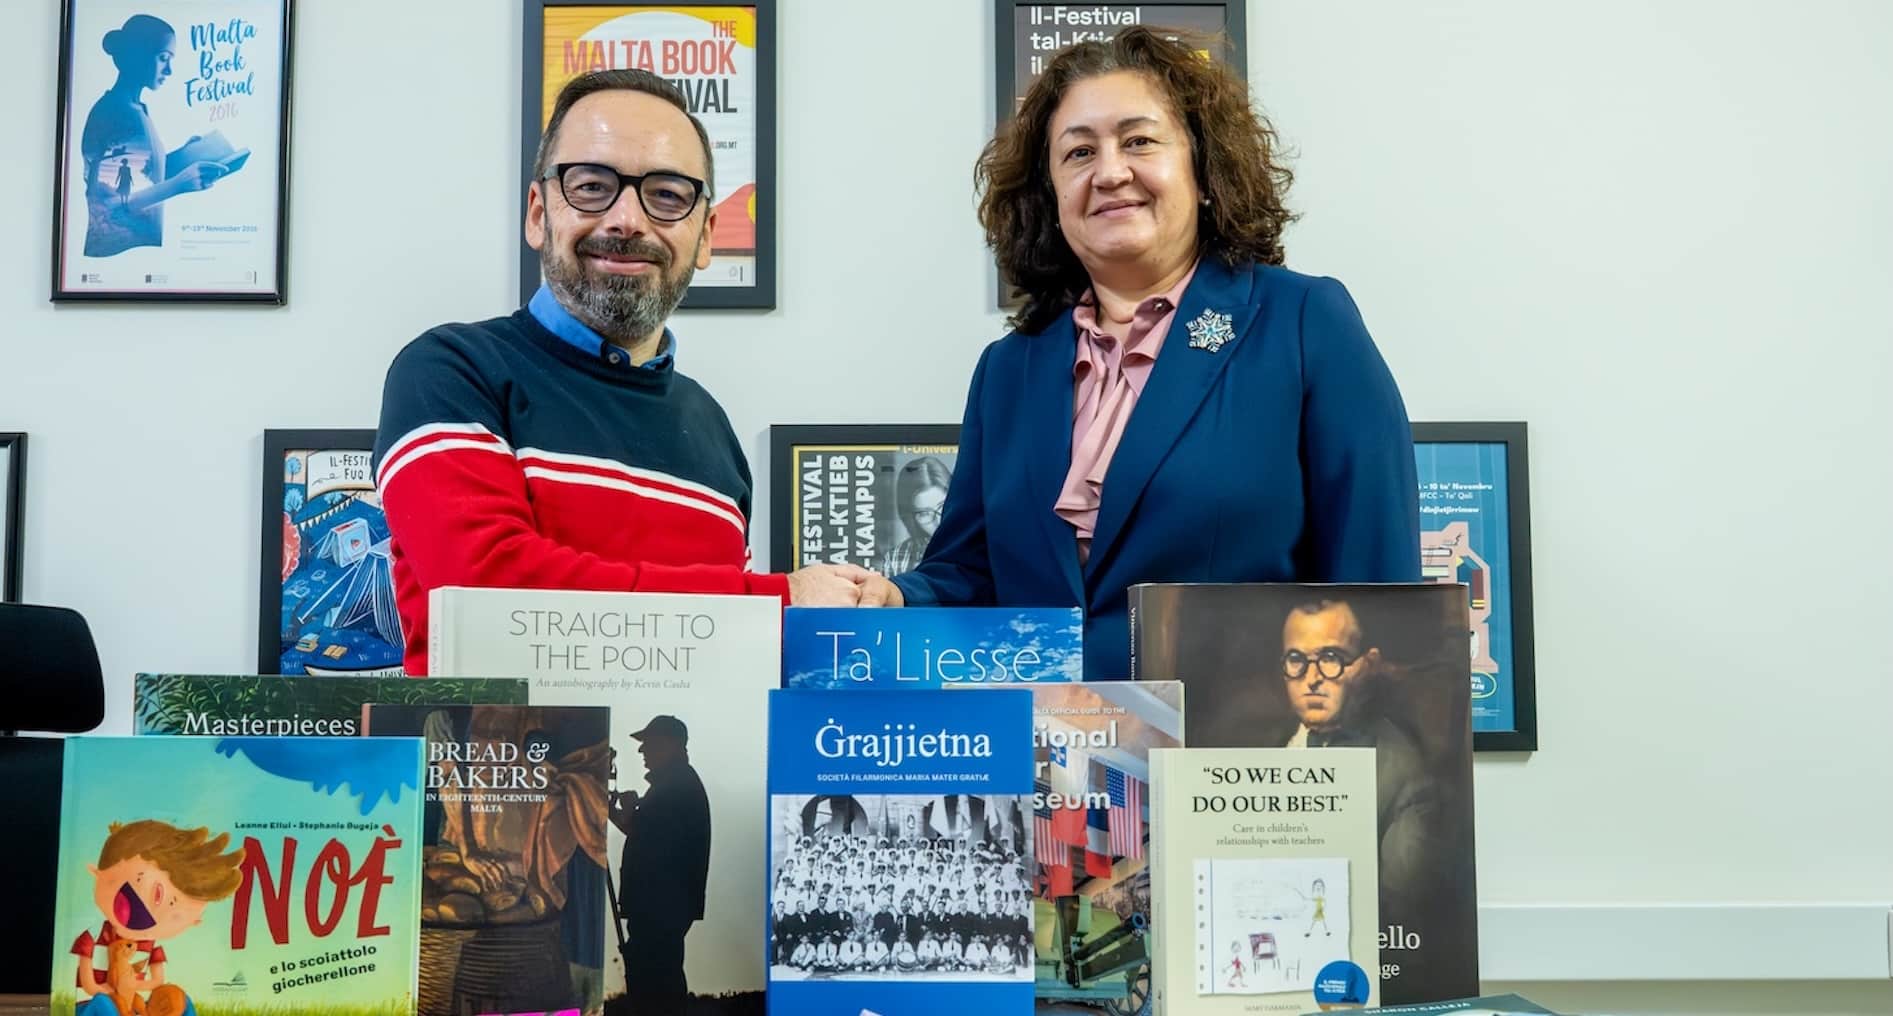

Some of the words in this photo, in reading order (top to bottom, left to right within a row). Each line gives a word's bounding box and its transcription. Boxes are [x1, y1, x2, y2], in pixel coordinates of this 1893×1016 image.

[1030, 6, 1141, 25] Il-Festival
[191, 19, 255, 51] Malta
[712, 21, 737, 38] THE
[1030, 31, 1114, 50] tal-Kti
[200, 46, 246, 80] Book
[563, 40, 655, 75] MALTA
[662, 40, 737, 75] BOOK
[1030, 56, 1049, 75] il-
[184, 72, 254, 107] Festival
[671, 78, 738, 113] IVAL
[209, 103, 239, 122] 2016
[329, 454, 372, 468] IL-FESTI
[344, 468, 364, 480] FUQ
[803, 455, 823, 565] FESTIVAL
[829, 455, 849, 565] AL-KTIEB
[855, 455, 875, 572] -KAMPUS
[509, 610, 664, 637] STRAIGHT
[675, 614, 715, 639] TO
[529, 644, 591, 670] THE
[602, 646, 696, 671] POINT
[816, 631, 883, 681] Ta’
[896, 631, 1041, 682] Liesse
[536, 678, 550, 689] An
[551, 679, 620, 691] autobiography
[621, 680, 634, 690] by
[183, 712, 356, 737] Masterpieces
[1033, 720, 1118, 748] tional
[428, 742, 518, 762] BREAD
[526, 742, 550, 763] &
[815, 718, 992, 766] Ġrajjietna
[427, 765, 548, 789] BAKERS
[851, 773, 903, 782] FILARMONICA
[905, 773, 930, 782] MARIA
[932, 773, 958, 782] MATER
[1246, 767, 1282, 784] WE
[1287, 767, 1336, 784] CAN
[426, 793, 437, 801] IN
[438, 793, 547, 802] EIGHTEENTH-CENTURY
[470, 804, 502, 813] MALTA
[1033, 792, 1111, 810] seum
[1192, 796, 1226, 813] DO
[1232, 796, 1281, 813] OUR
[234, 821, 268, 829] Leanne
[298, 821, 345, 831] Stephanie
[1232, 823, 1255, 833] Care
[1256, 823, 1265, 833] in
[1267, 822, 1309, 833] children's
[1216, 836, 1269, 848] relationships
[1271, 836, 1289, 846] with
[1291, 836, 1325, 846] teachers
[231, 824, 402, 950] NOÈ
[1379, 925, 1421, 949] ello
[270, 965, 278, 974] e
[281, 961, 296, 972] lo
[299, 945, 377, 969] scoiattolo
[272, 963, 376, 994] giocherellone
